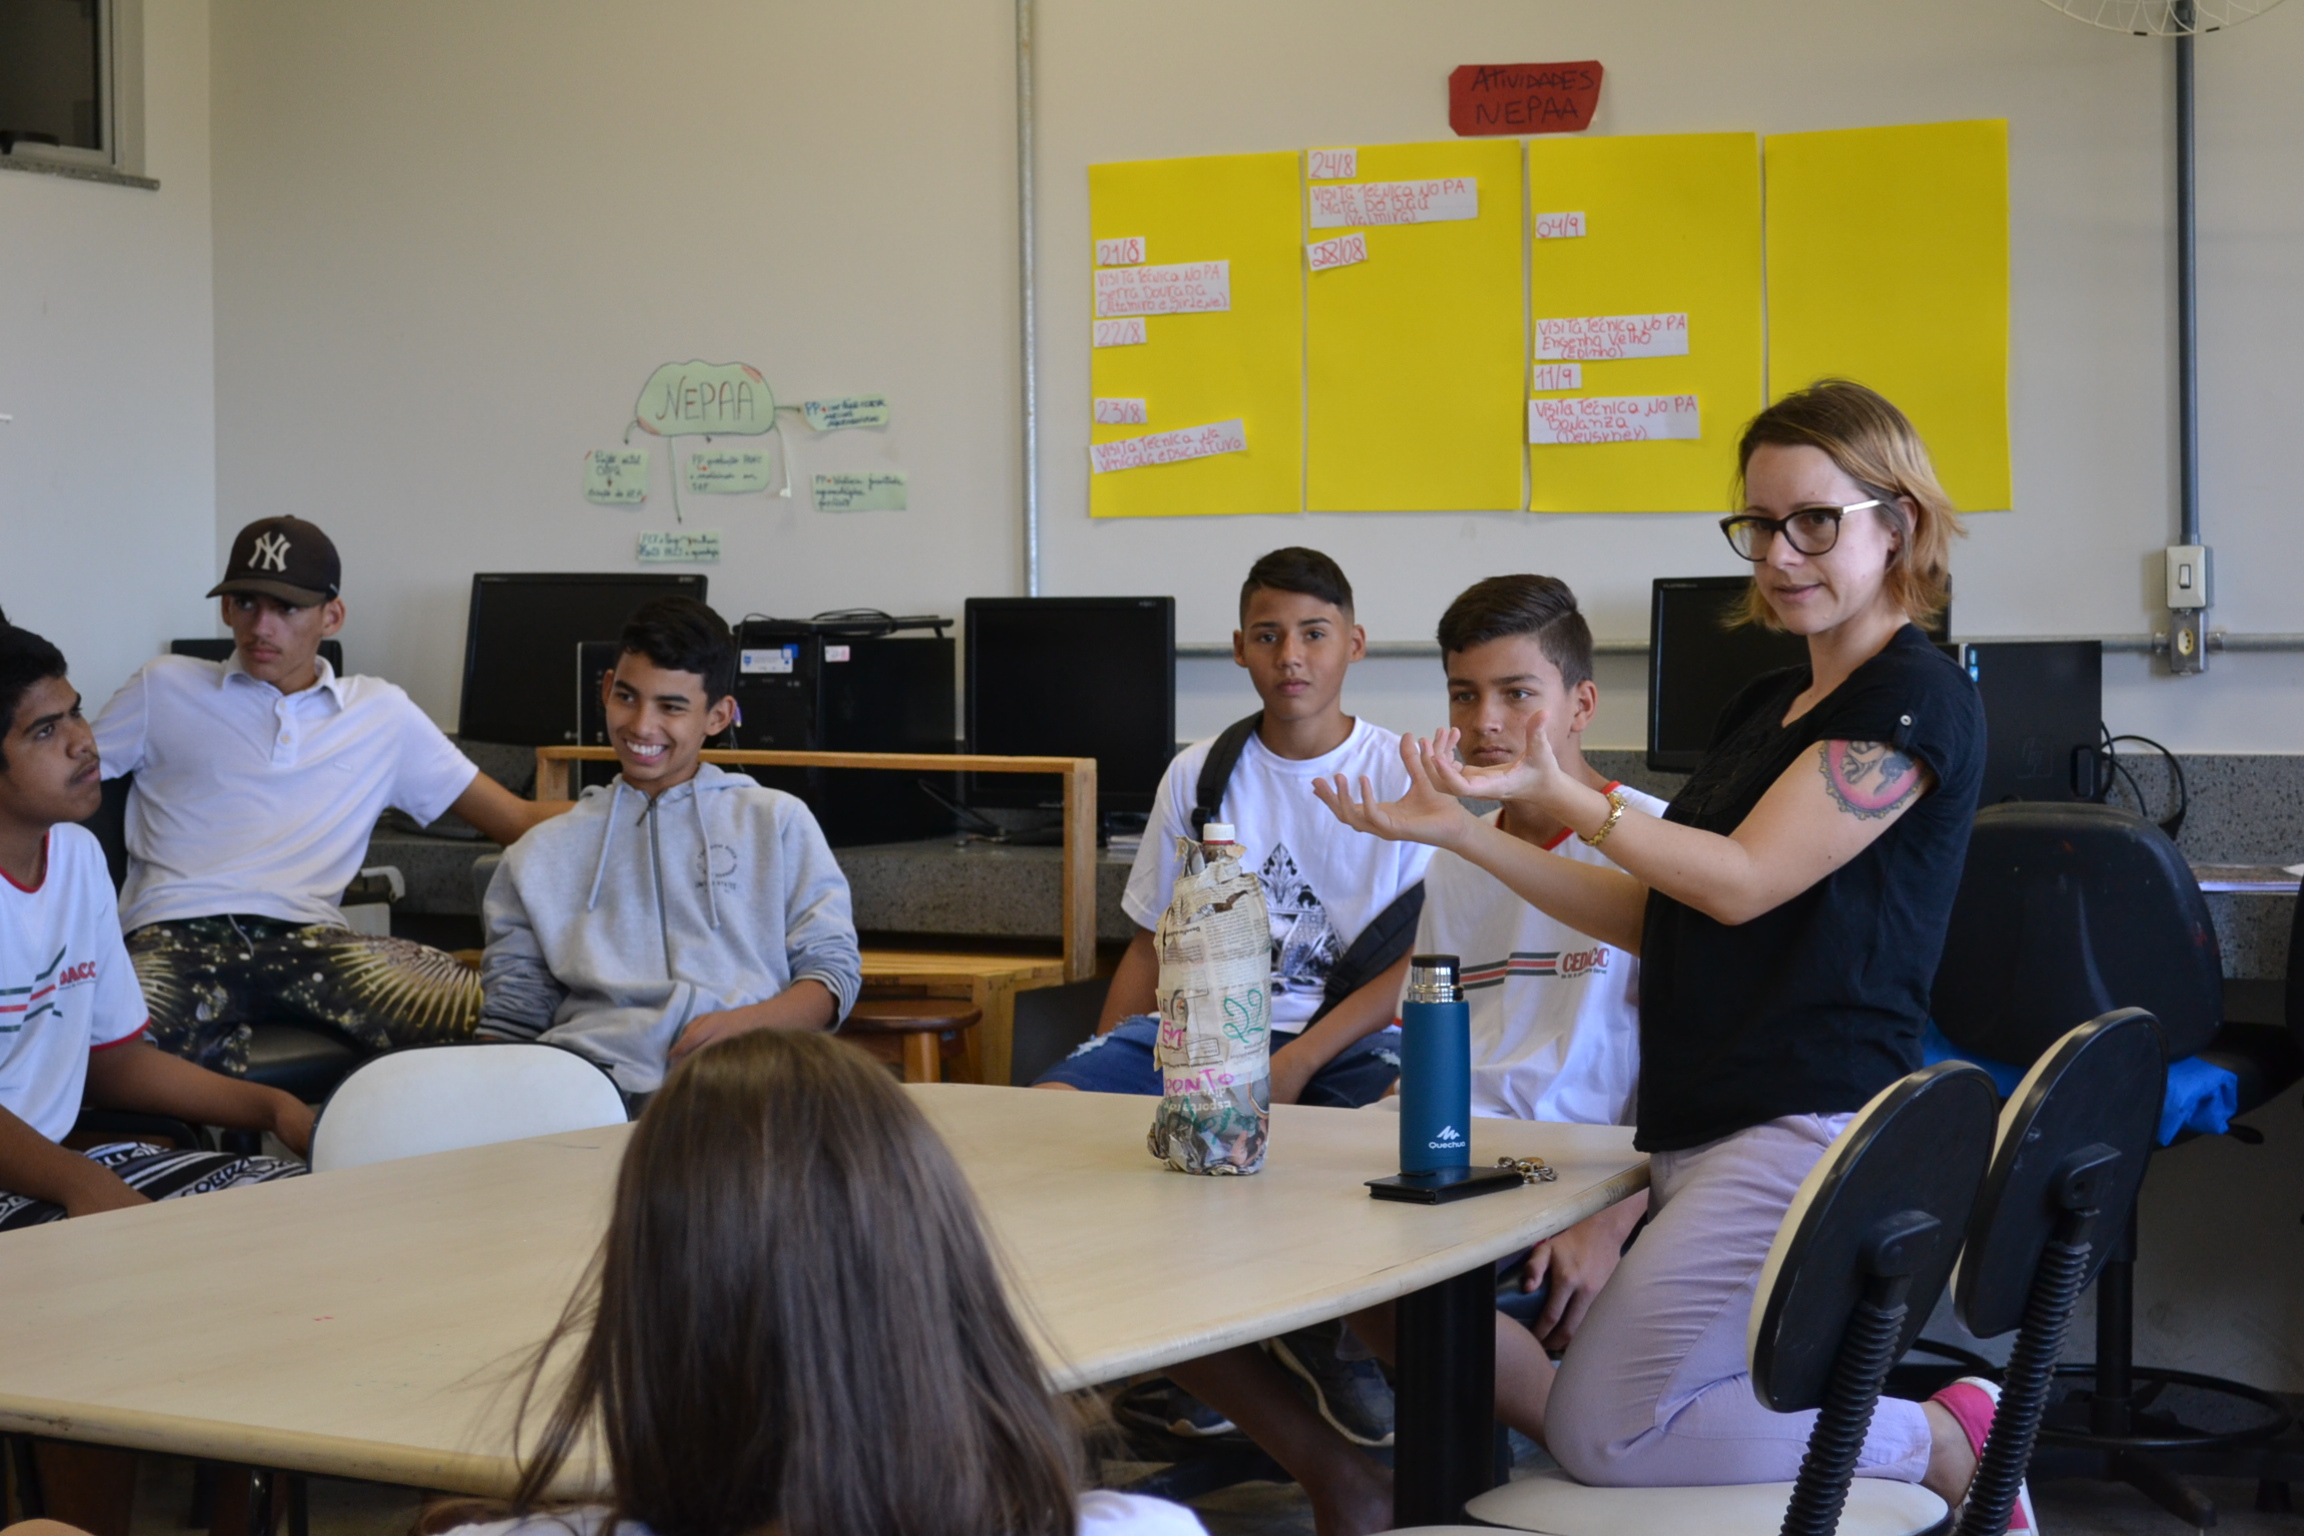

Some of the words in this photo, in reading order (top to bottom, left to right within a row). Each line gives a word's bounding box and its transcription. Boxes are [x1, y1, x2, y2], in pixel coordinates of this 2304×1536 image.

[1471, 67, 1594, 92] ATIVIDADES
[1476, 95, 1578, 124] NEPAA
[1311, 151, 1354, 178] 24/8
[1443, 179, 1466, 195] PA
[1536, 212, 1579, 238] 04/9
[1100, 239, 1140, 266] 21/8
[1204, 264, 1221, 280] PA
[1097, 321, 1141, 345] 22/8
[1666, 314, 1686, 331] PA
[1536, 365, 1573, 390] 11/9
[656, 376, 754, 421] NEPAA
[1674, 395, 1698, 412] PA
[1097, 400, 1141, 424] 23/8
[248, 531, 292, 573] NY
[1428, 1141, 1466, 1150] Quechua
